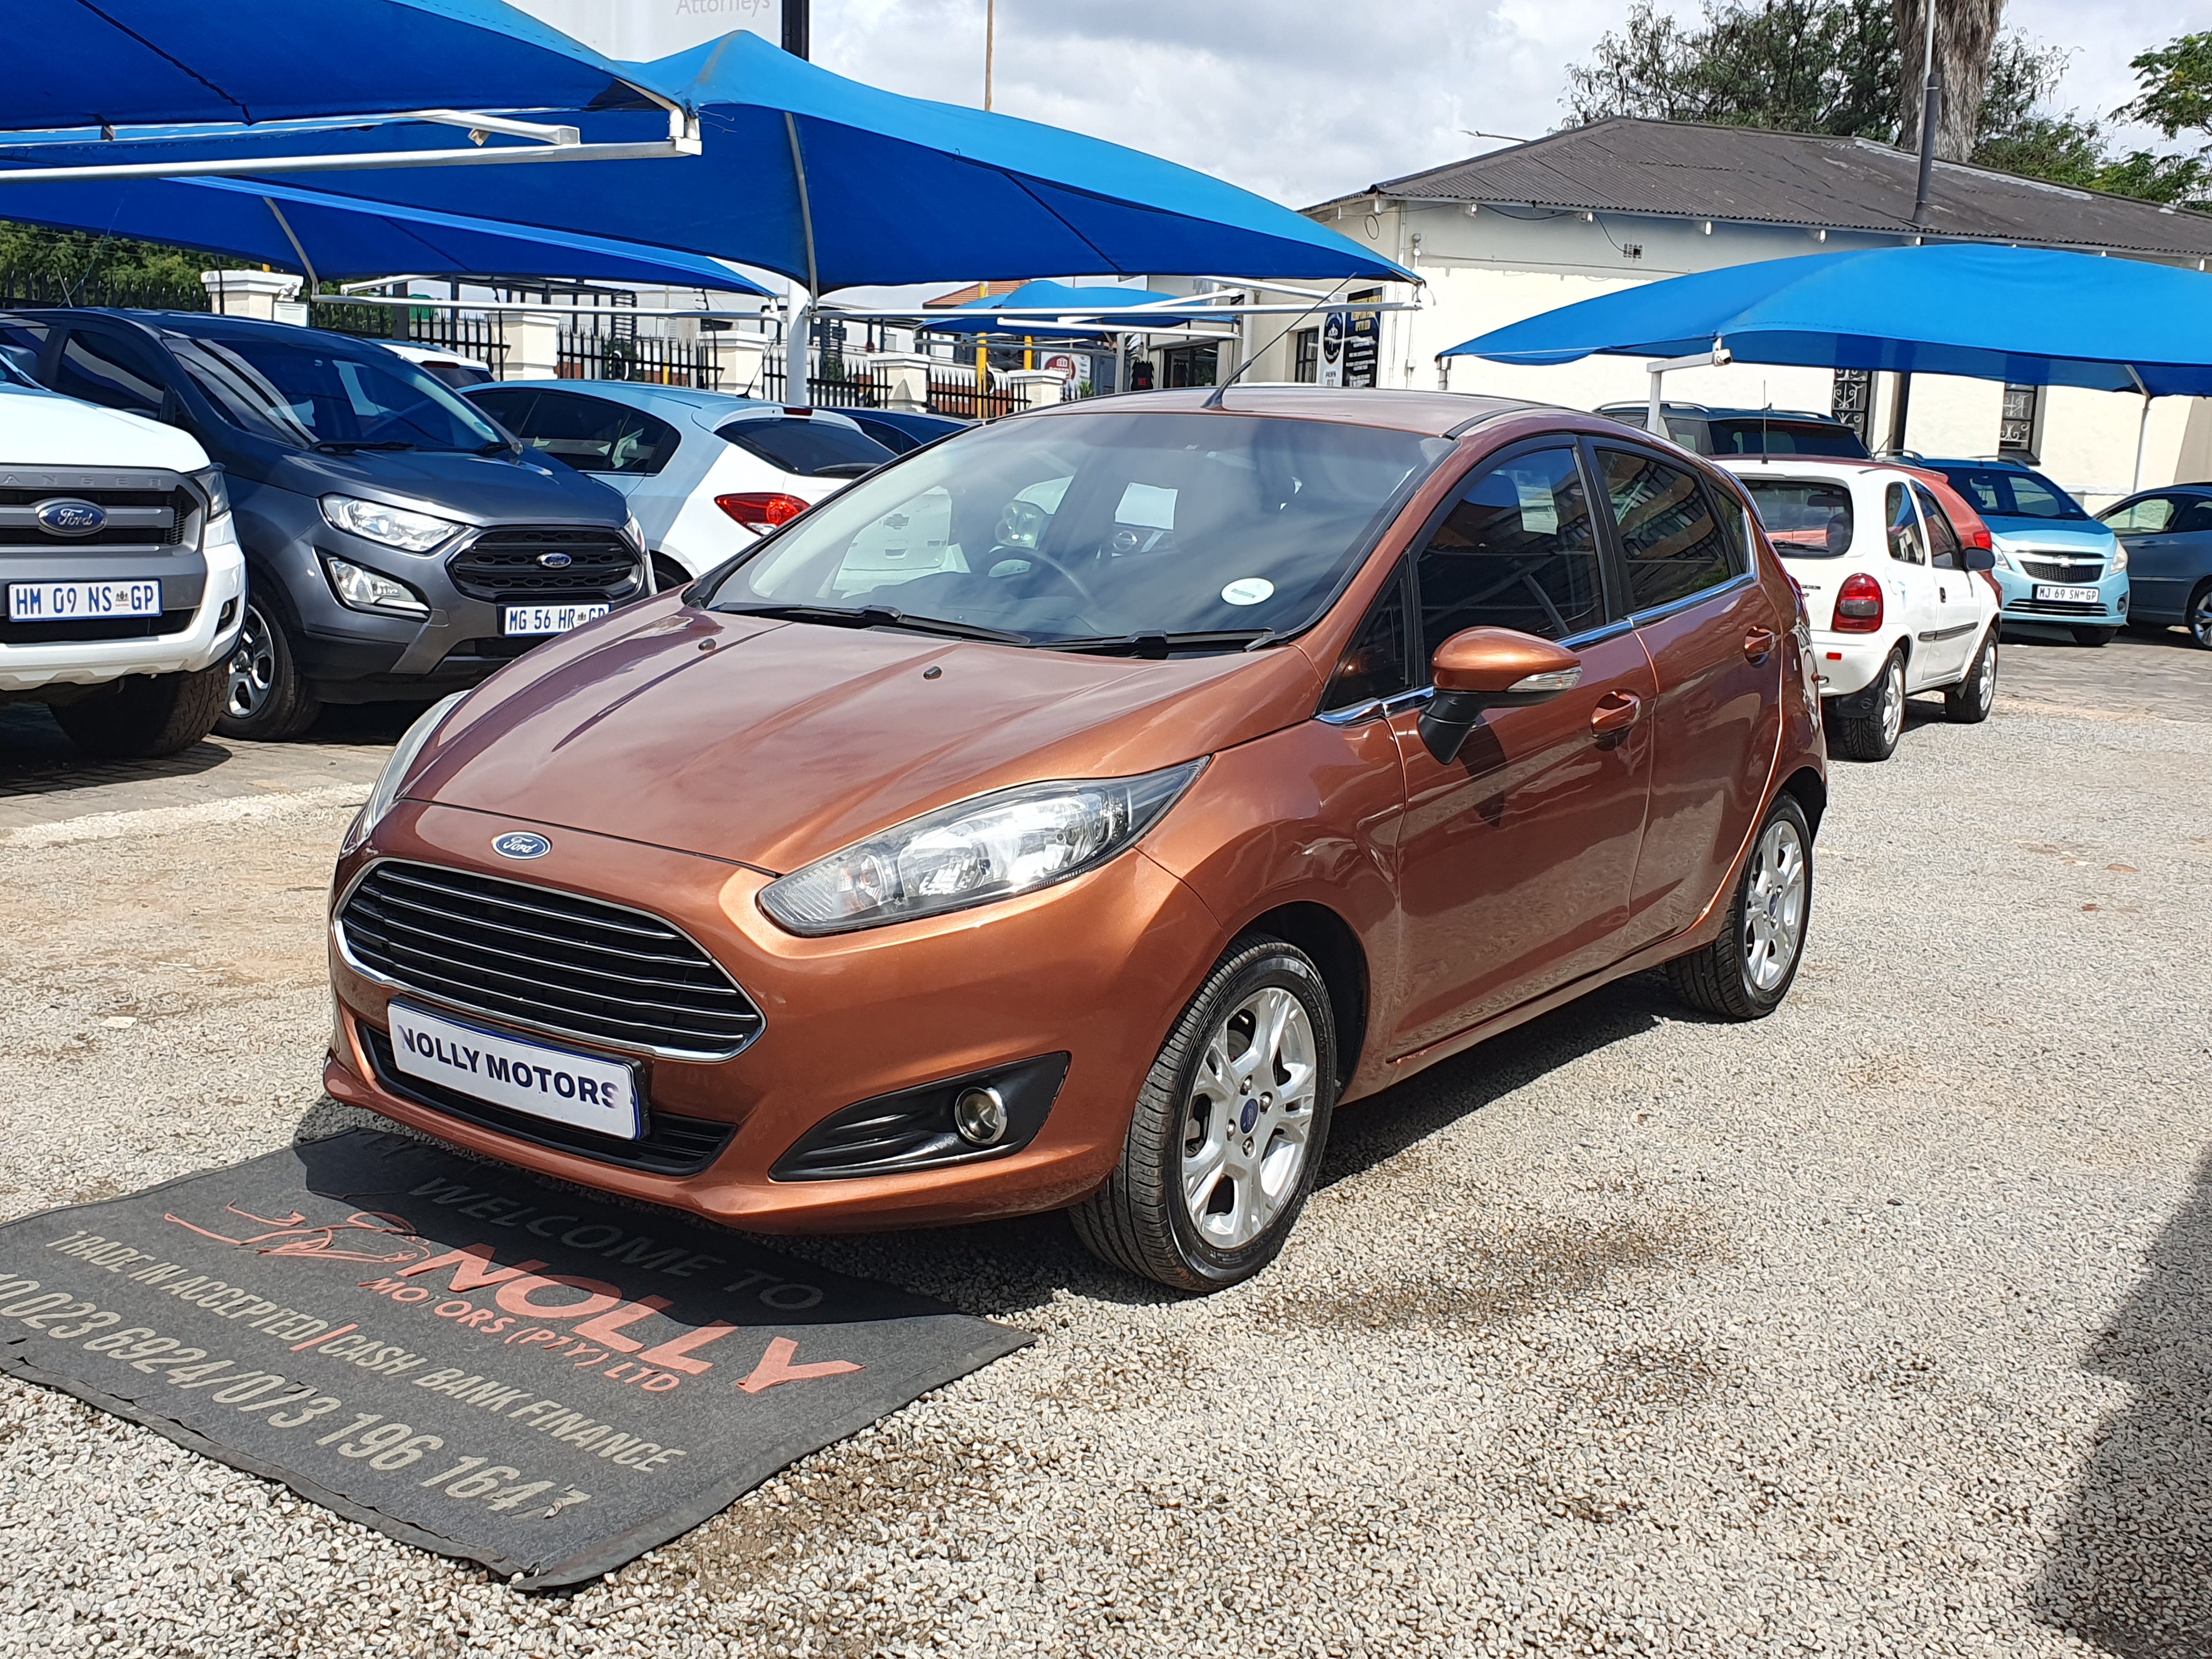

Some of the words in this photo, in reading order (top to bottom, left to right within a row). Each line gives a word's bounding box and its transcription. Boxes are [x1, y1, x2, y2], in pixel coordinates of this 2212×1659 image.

[676, 0, 771, 18] Attorneys
[58, 508, 92, 526] Ford
[16, 588, 41, 615] HM
[53, 588, 77, 613] 09
[88, 586, 112, 612] NS
[131, 585, 154, 611] GP
[2055, 589, 2065, 599] 69
[2069, 590, 2079, 599] SN
[2086, 591, 2096, 600] GP
[510, 610, 527, 631] MG
[534, 610, 551, 629] 56
[558, 608, 575, 629] HR
[503, 837, 538, 853] Ford
[397, 1024, 480, 1073] NOLLY
[486, 1053, 619, 1109] MOTORS
[408, 1177, 726, 1277] WELCOME
[724, 1268, 825, 1310] TO
[396, 1243, 866, 1394] NOLLY
[358, 1278, 516, 1333] MOORS
[603, 1362, 680, 1391] LTD
[45, 1231, 157, 1273] TRADE
[127, 1262, 189, 1285] IN
[412, 1368, 534, 1412] BANK
[507, 1400, 687, 1472] FINANCE
